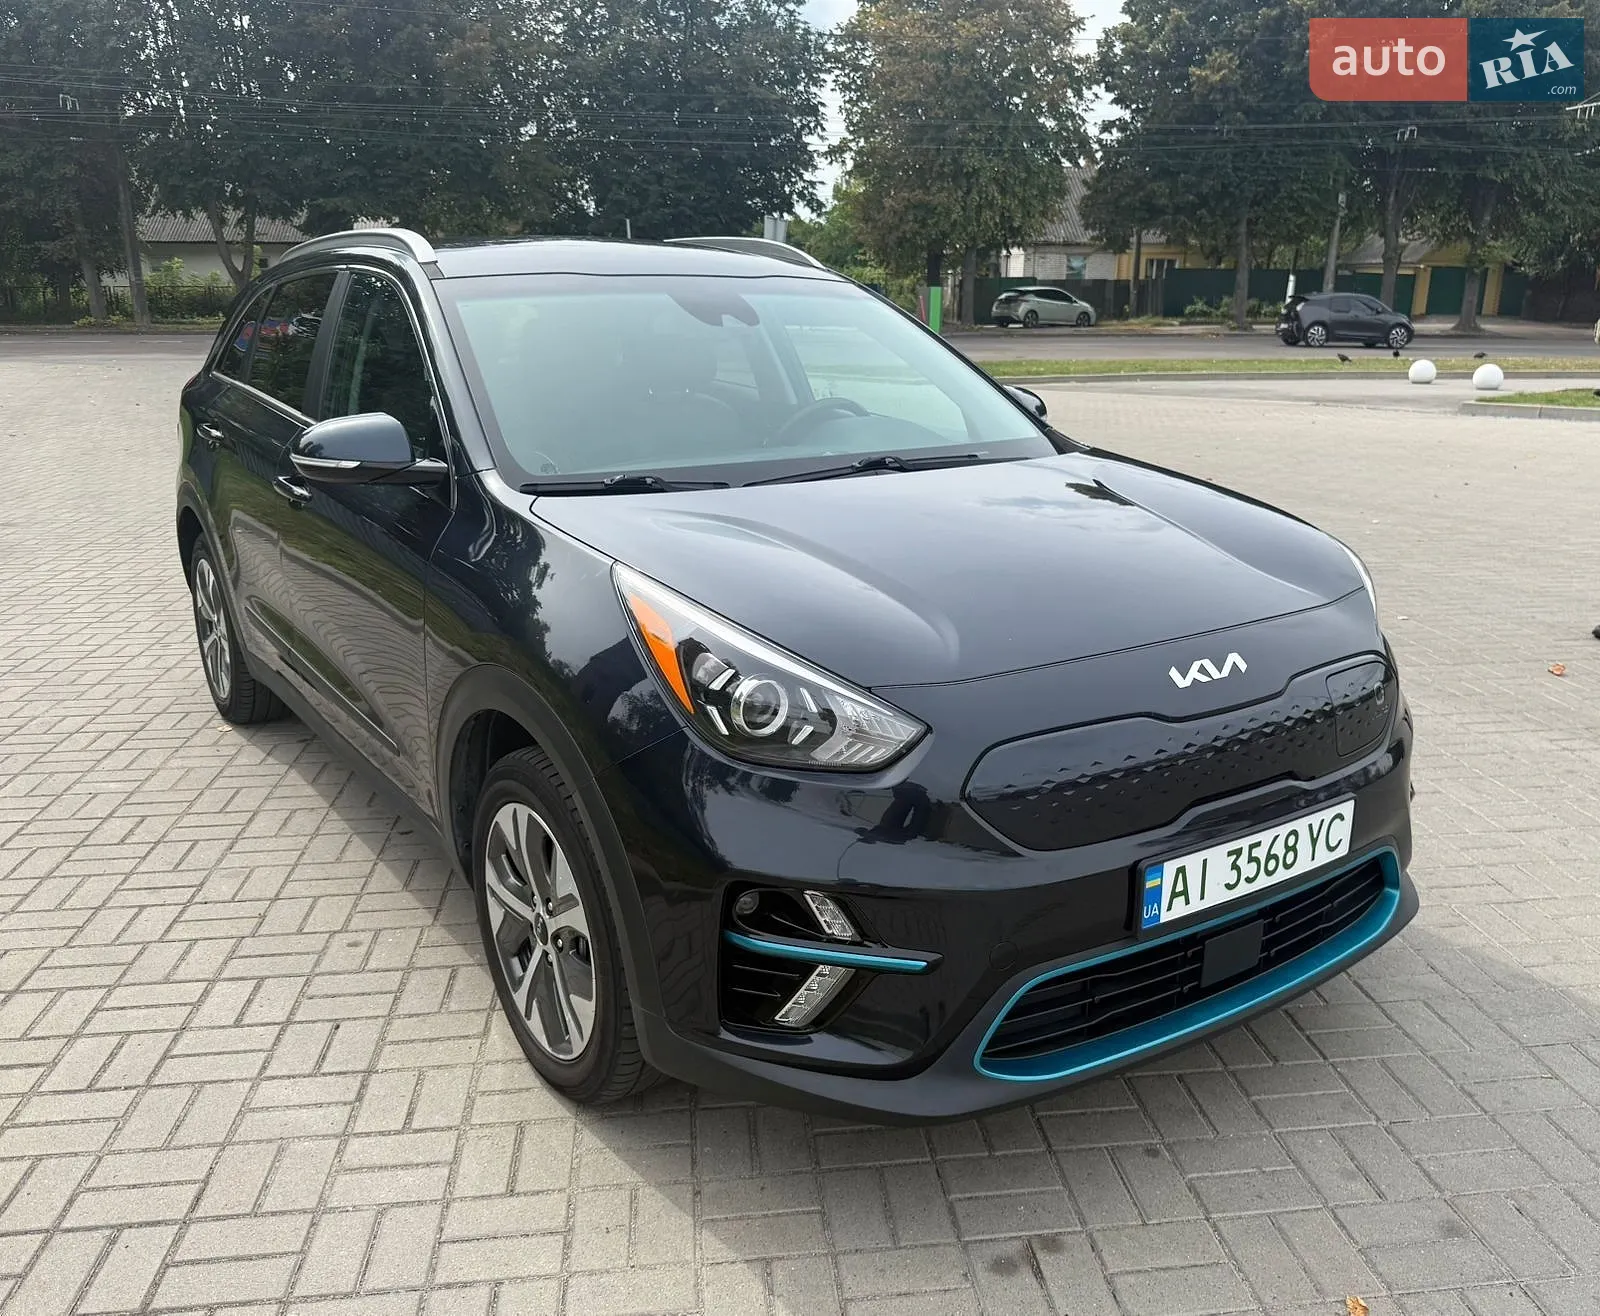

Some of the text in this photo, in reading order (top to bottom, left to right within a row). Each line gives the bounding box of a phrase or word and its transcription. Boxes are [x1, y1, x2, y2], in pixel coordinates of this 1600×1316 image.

[1168, 652, 1248, 689] KIA
[1166, 812, 1345, 912] AI 3568 YC
[1143, 903, 1159, 919] UA
